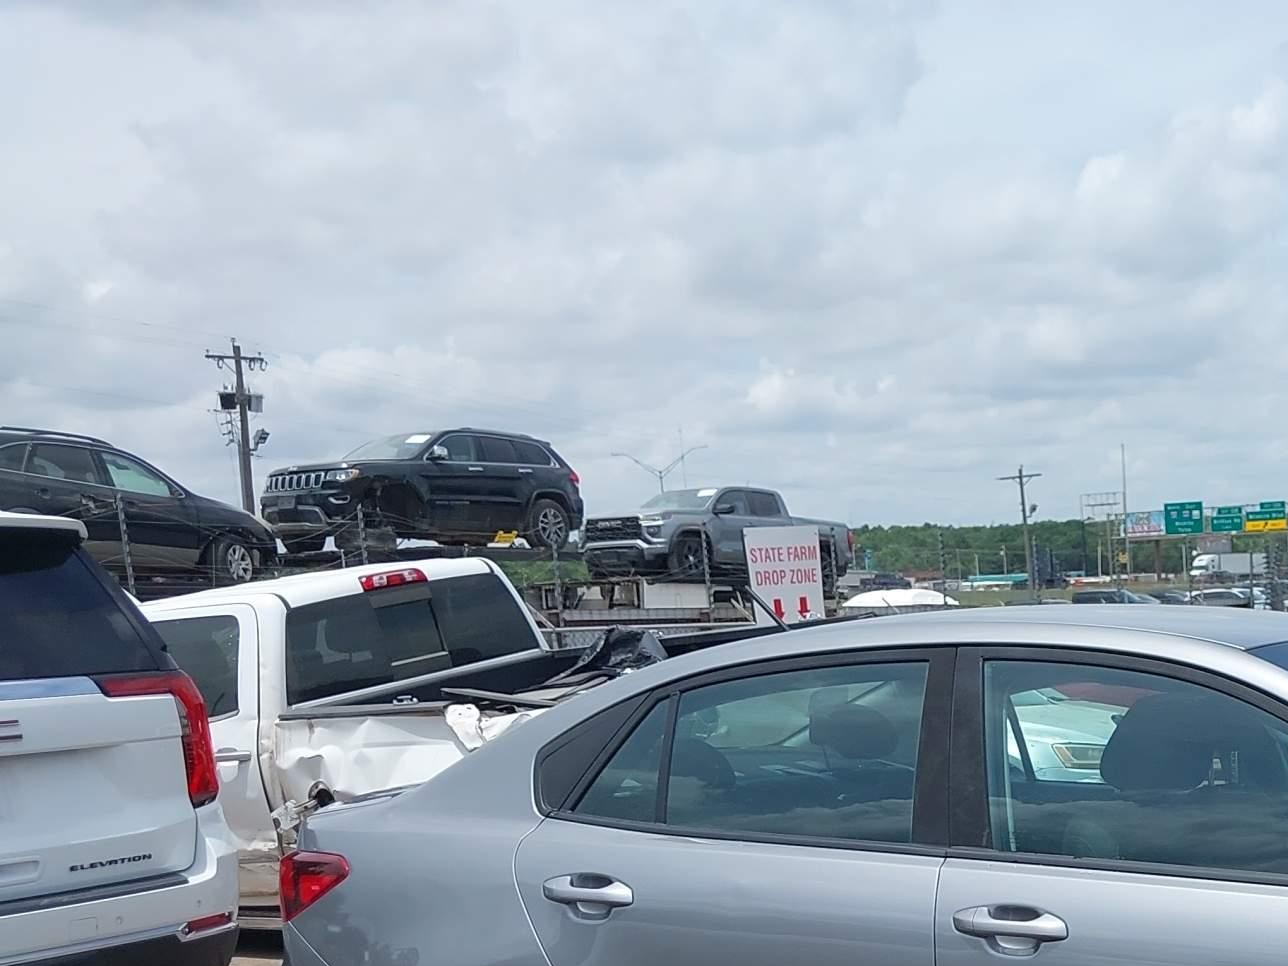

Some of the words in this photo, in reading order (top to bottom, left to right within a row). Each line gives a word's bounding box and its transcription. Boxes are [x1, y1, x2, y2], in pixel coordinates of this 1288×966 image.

[750, 547, 784, 564] STATE
[787, 545, 818, 561] FARM
[755, 570, 787, 587] DROP
[790, 568, 818, 585] ZONE
[69, 853, 152, 872] ELEVATION
